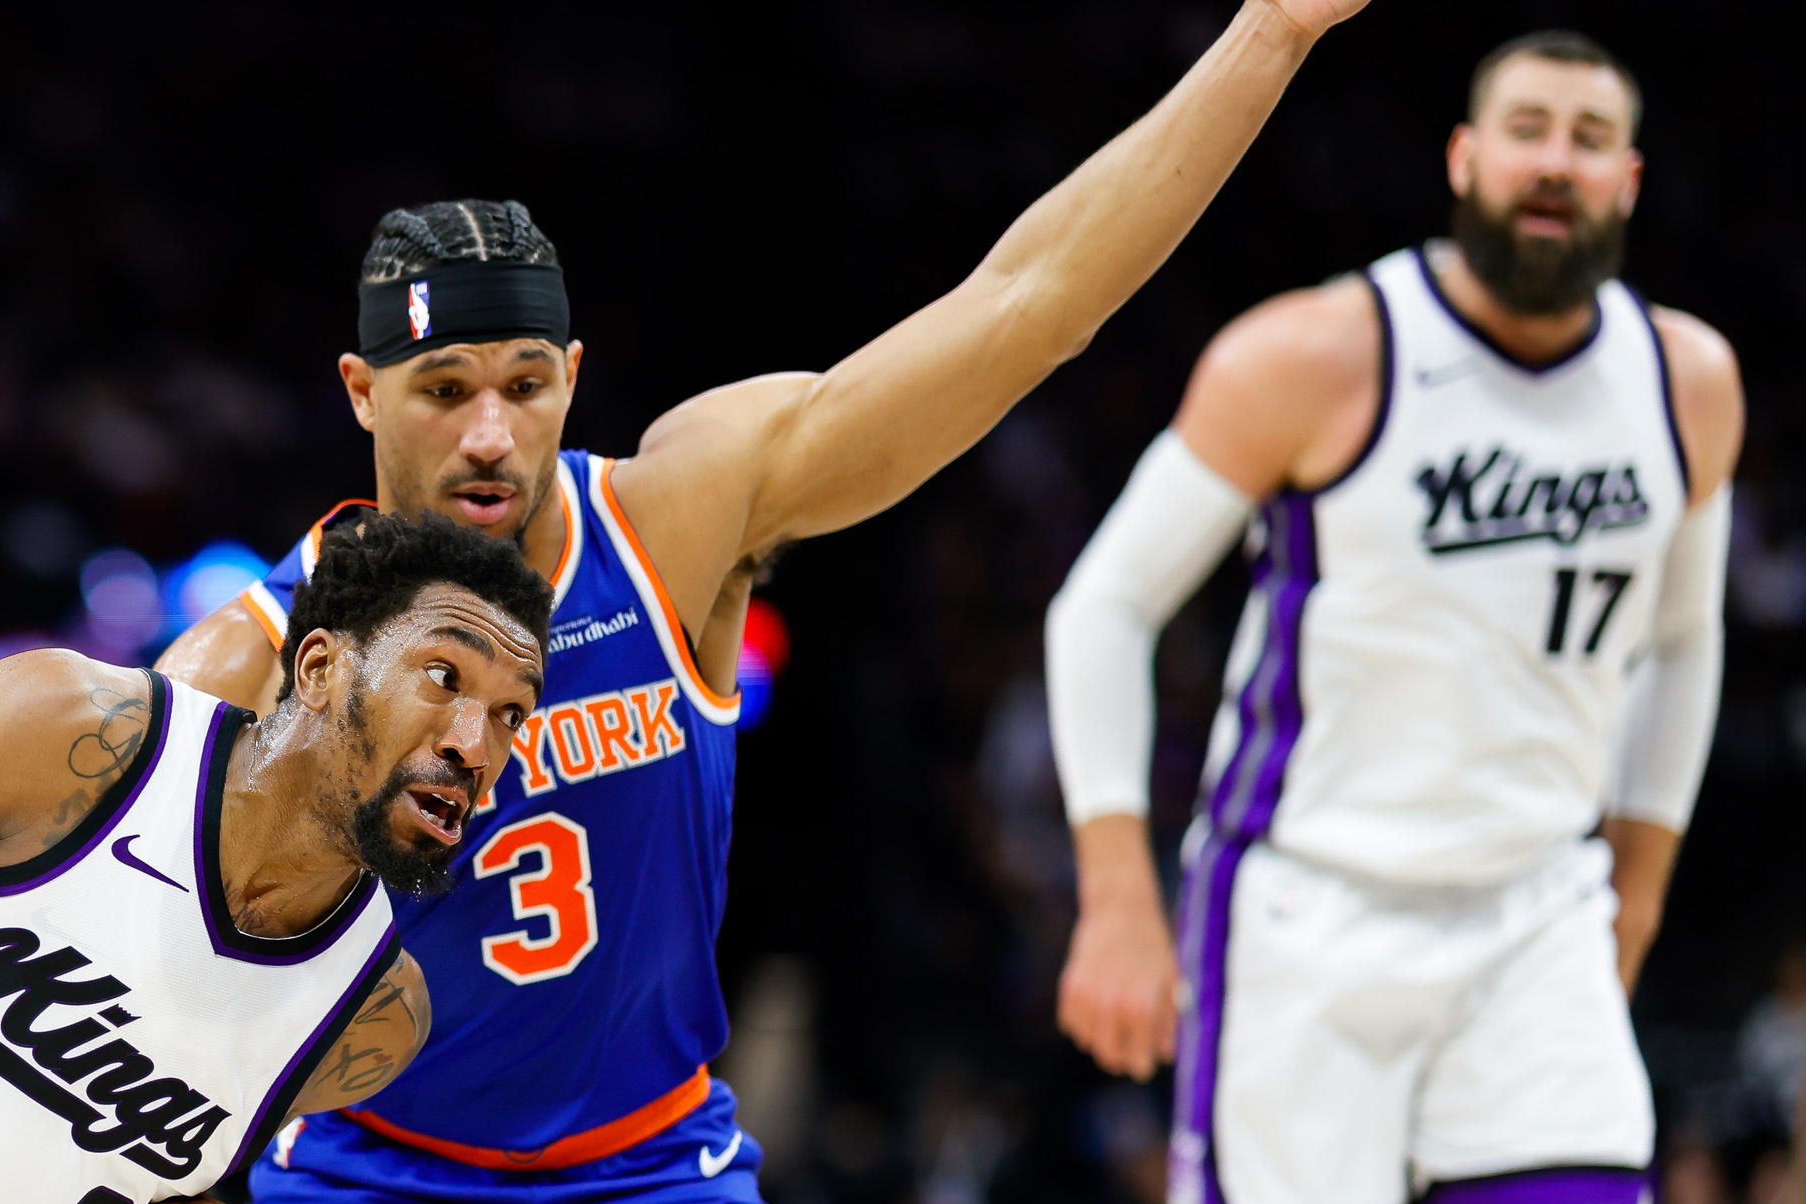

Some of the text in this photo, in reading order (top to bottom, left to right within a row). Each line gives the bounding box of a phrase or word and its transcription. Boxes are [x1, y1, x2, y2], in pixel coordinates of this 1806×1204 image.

[1413, 444, 1650, 556] Kings
[547, 631, 585, 654] abu
[584, 606, 639, 642] dhabi
[1545, 567, 1635, 656] 17
[511, 677, 686, 798] YORK
[473, 811, 598, 986] 3
